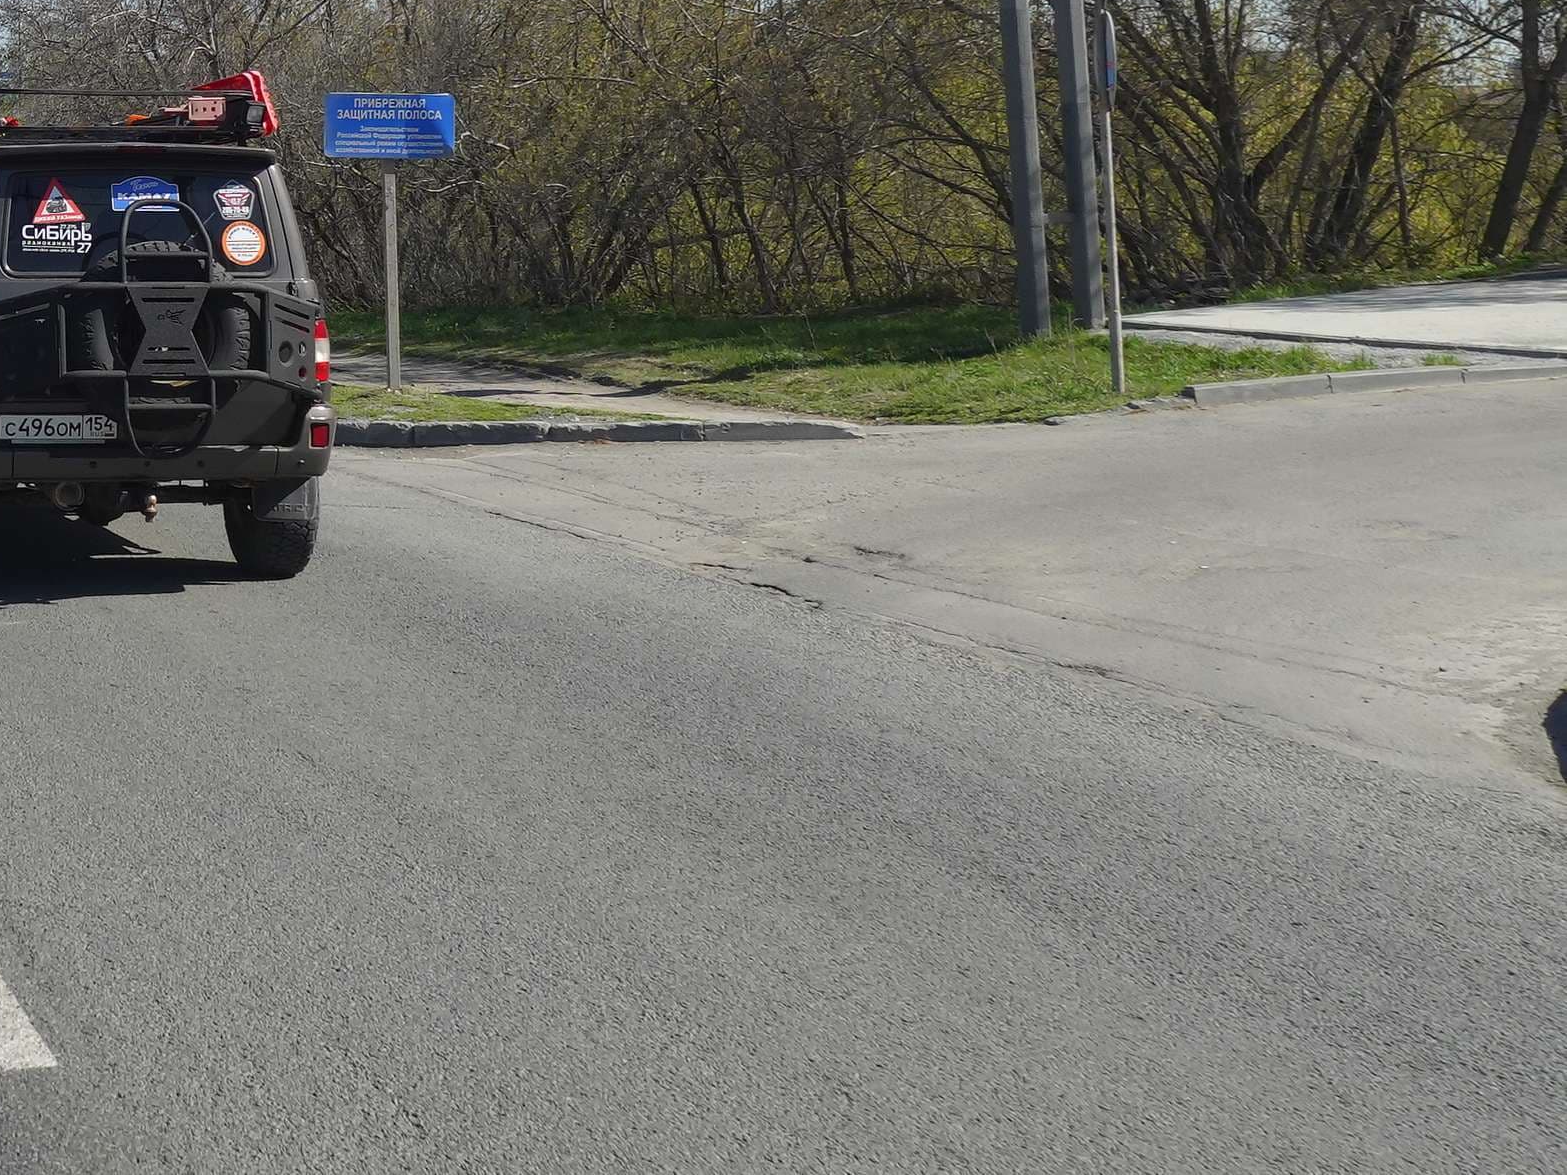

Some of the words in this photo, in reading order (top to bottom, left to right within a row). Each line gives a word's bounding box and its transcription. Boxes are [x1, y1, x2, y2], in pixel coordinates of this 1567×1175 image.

[353, 98, 426, 109] ПРИБРЕЖНАЯ
[337, 109, 395, 121] ЗАЩИТНАЯ
[397, 110, 443, 121] ПОЛОСА
[76, 242, 92, 254] 27
[85, 416, 114, 432] 154
